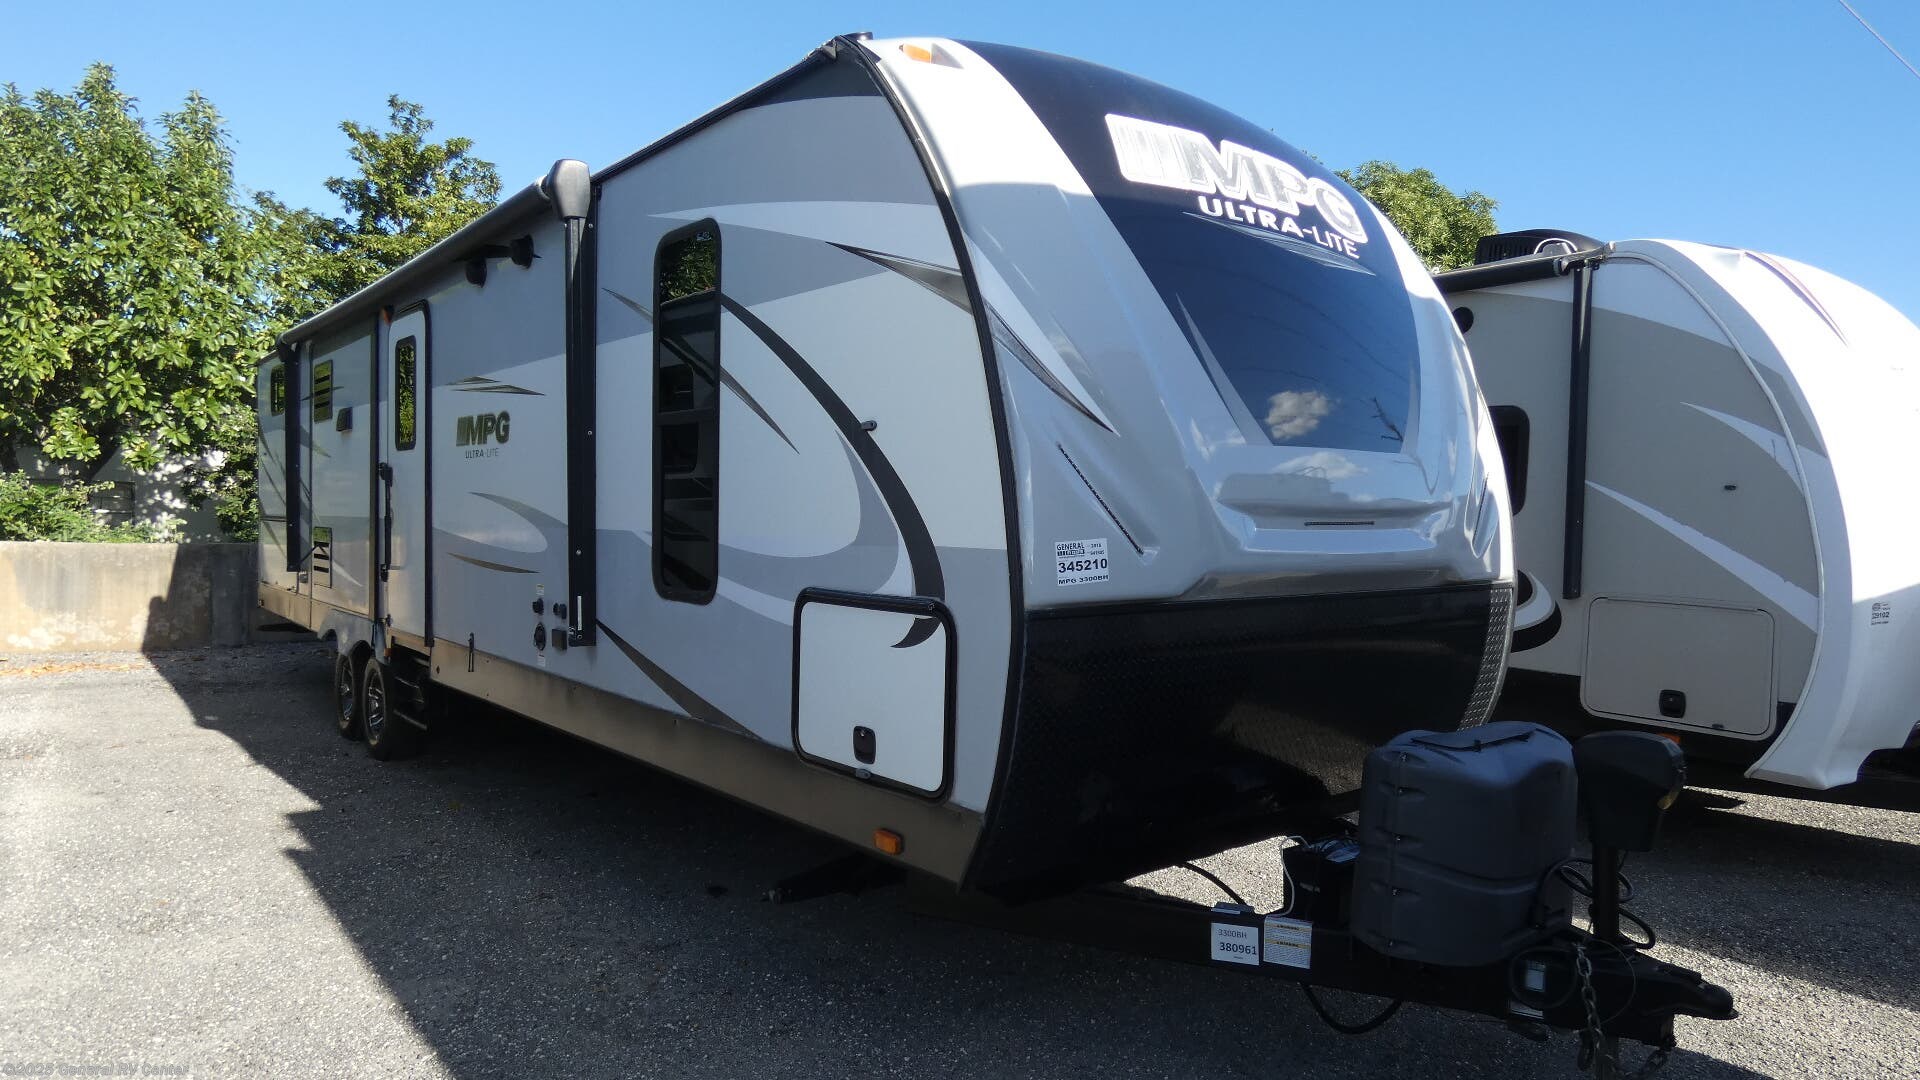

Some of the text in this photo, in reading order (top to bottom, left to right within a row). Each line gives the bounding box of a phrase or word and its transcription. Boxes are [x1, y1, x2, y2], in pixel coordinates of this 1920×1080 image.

[1105, 113, 1368, 243] MPG
[1198, 195, 1360, 259] ULTRA-LITE
[456, 411, 510, 446] MPG
[465, 448, 500, 459] ULTRA-LITE
[1057, 542, 1085, 551] GENERAL
[1058, 558, 1108, 573] 345210
[1218, 928, 1247, 939] 3300BH
[1219, 941, 1257, 955] 380961
